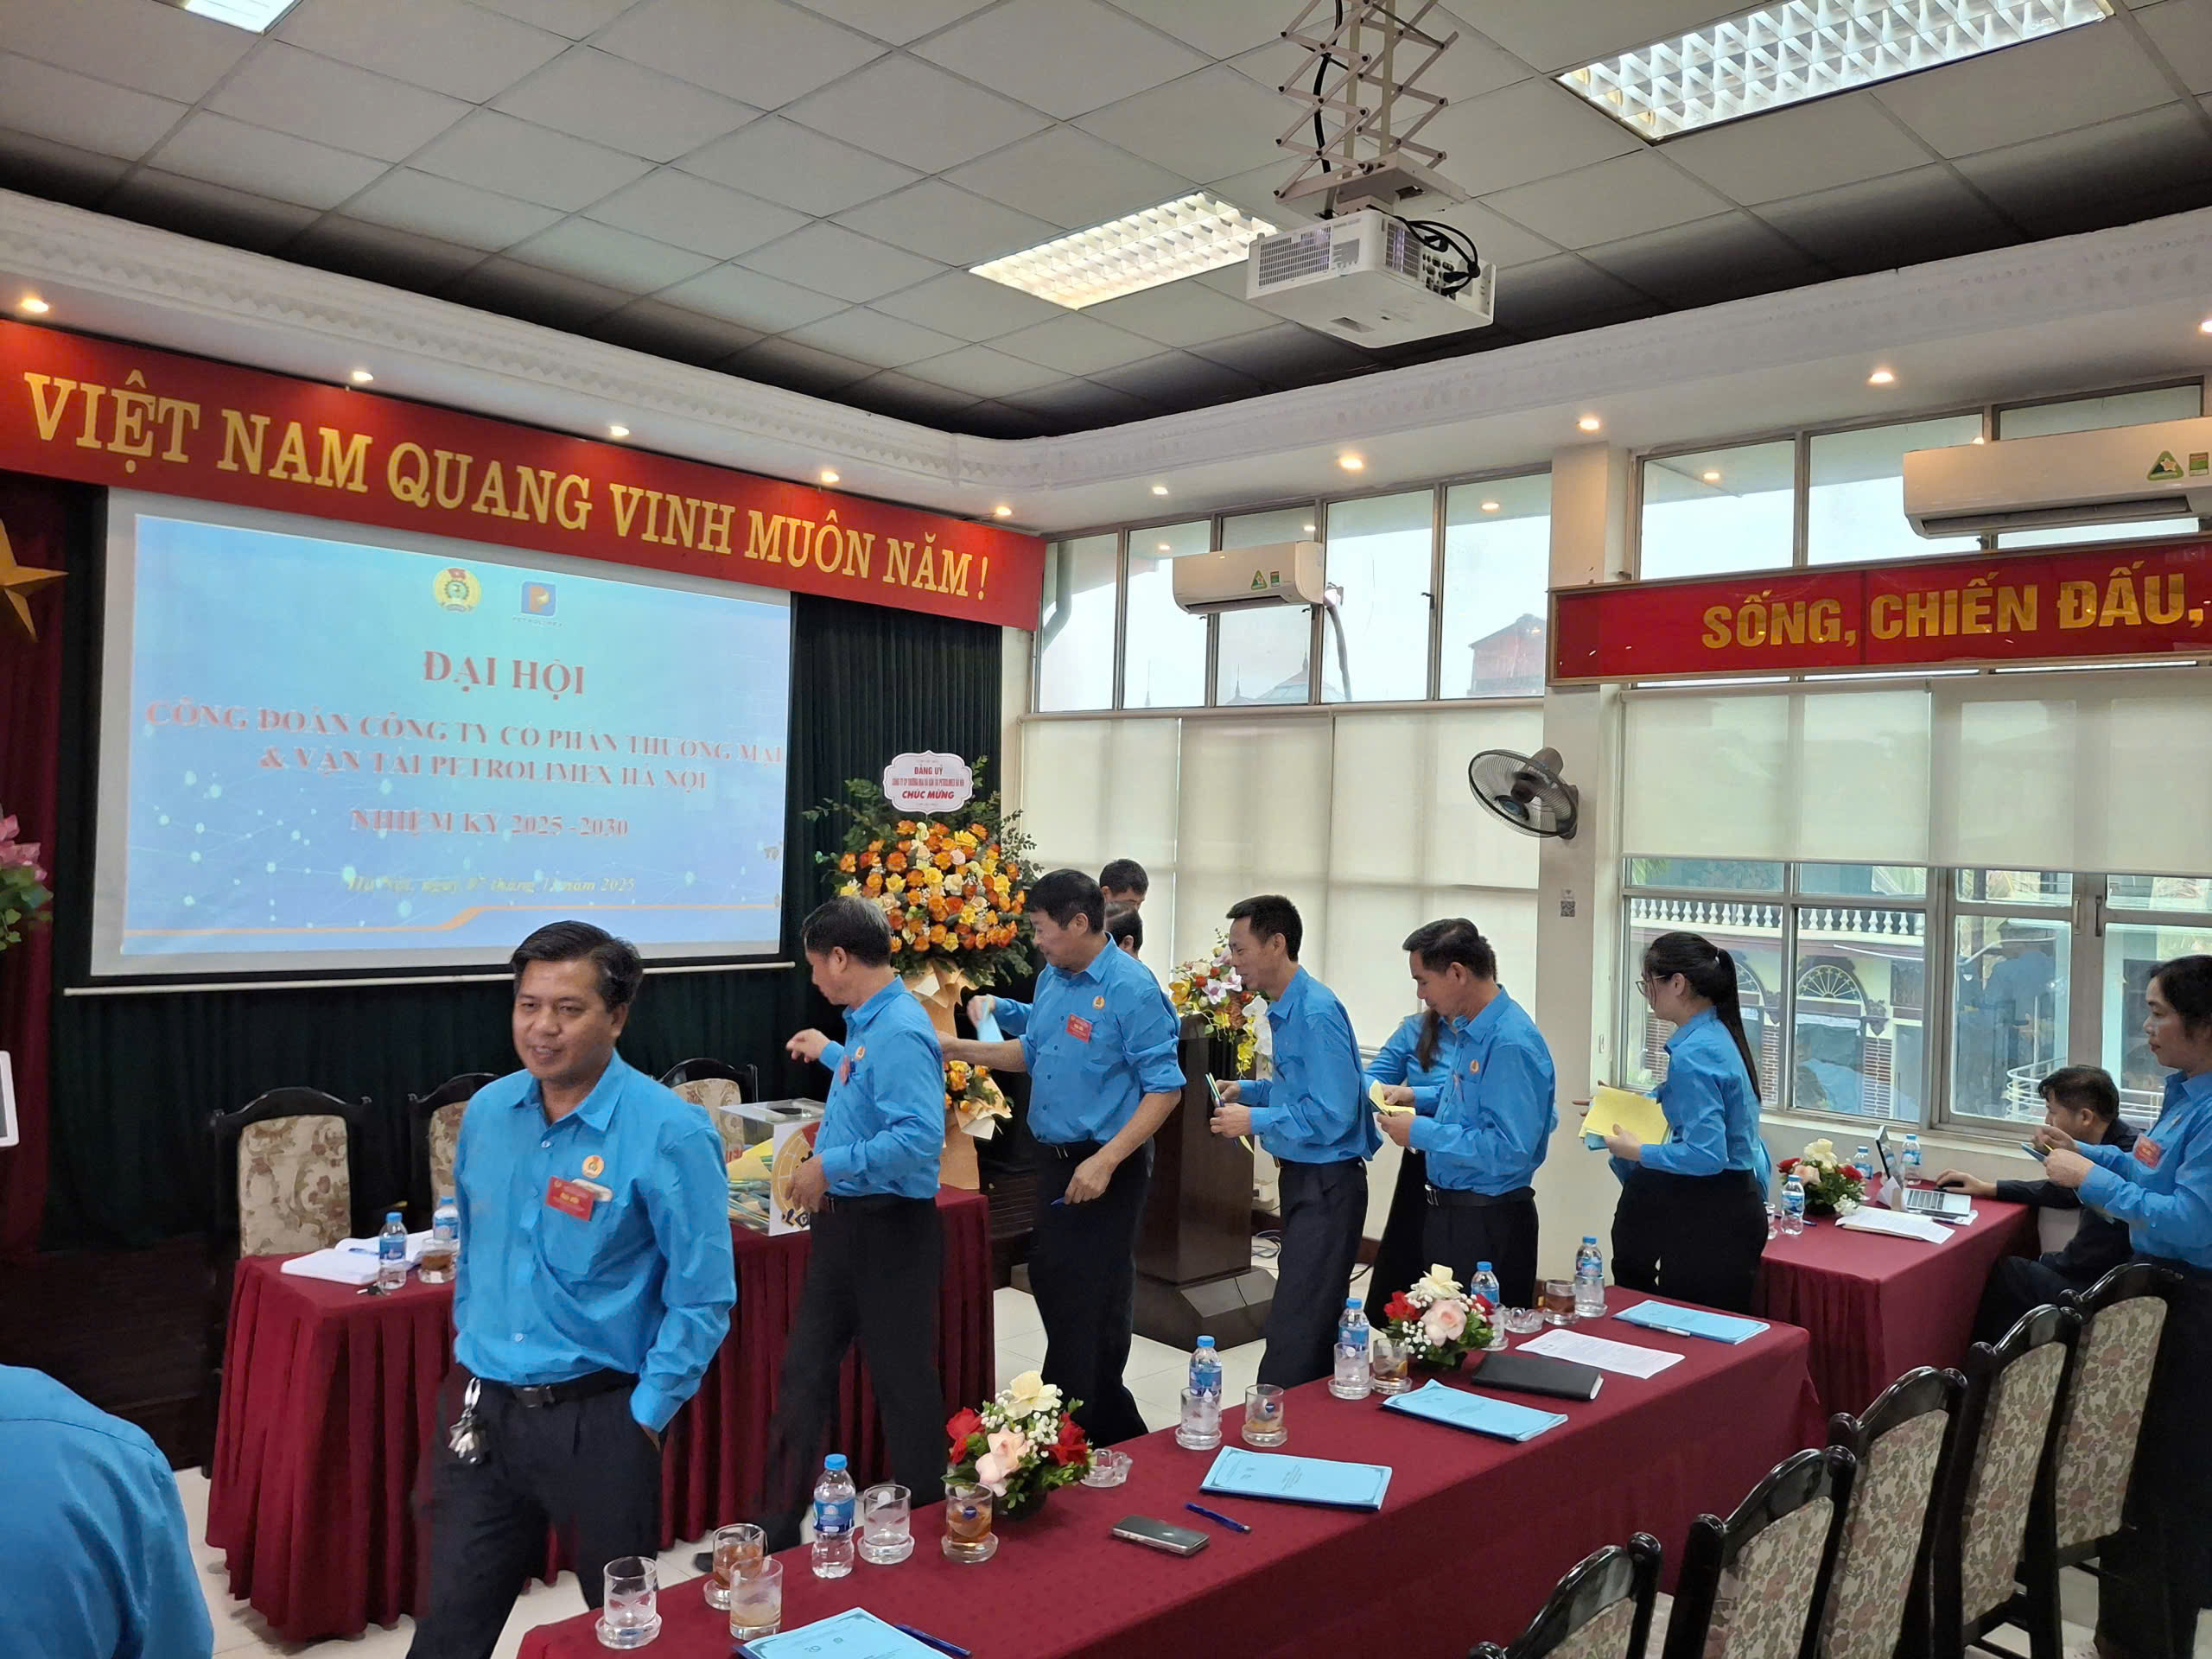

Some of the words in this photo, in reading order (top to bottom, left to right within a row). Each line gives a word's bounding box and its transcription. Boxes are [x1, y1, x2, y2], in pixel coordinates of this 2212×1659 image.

[23, 369, 200, 474] VIỆT
[216, 409, 373, 493] NAM
[387, 442, 593, 531] QUANG
[609, 482, 735, 556] VINH
[744, 509, 875, 579] MUÔN
[1701, 589, 1858, 649] SỐNG,
[1871, 571, 2037, 639] CHIẾN
[2057, 560, 2204, 629] ĐẤU,
[423, 651, 497, 692] ĐẠI
[512, 658, 585, 700] HỘI
[145, 695, 248, 730] CÔNG
[359, 711, 447, 742] CÔNG
[455, 722, 488, 744] TY
[259, 746, 284, 768] &
[664, 767, 707, 793] NỘI
[901, 788, 925, 799] CHÚC
